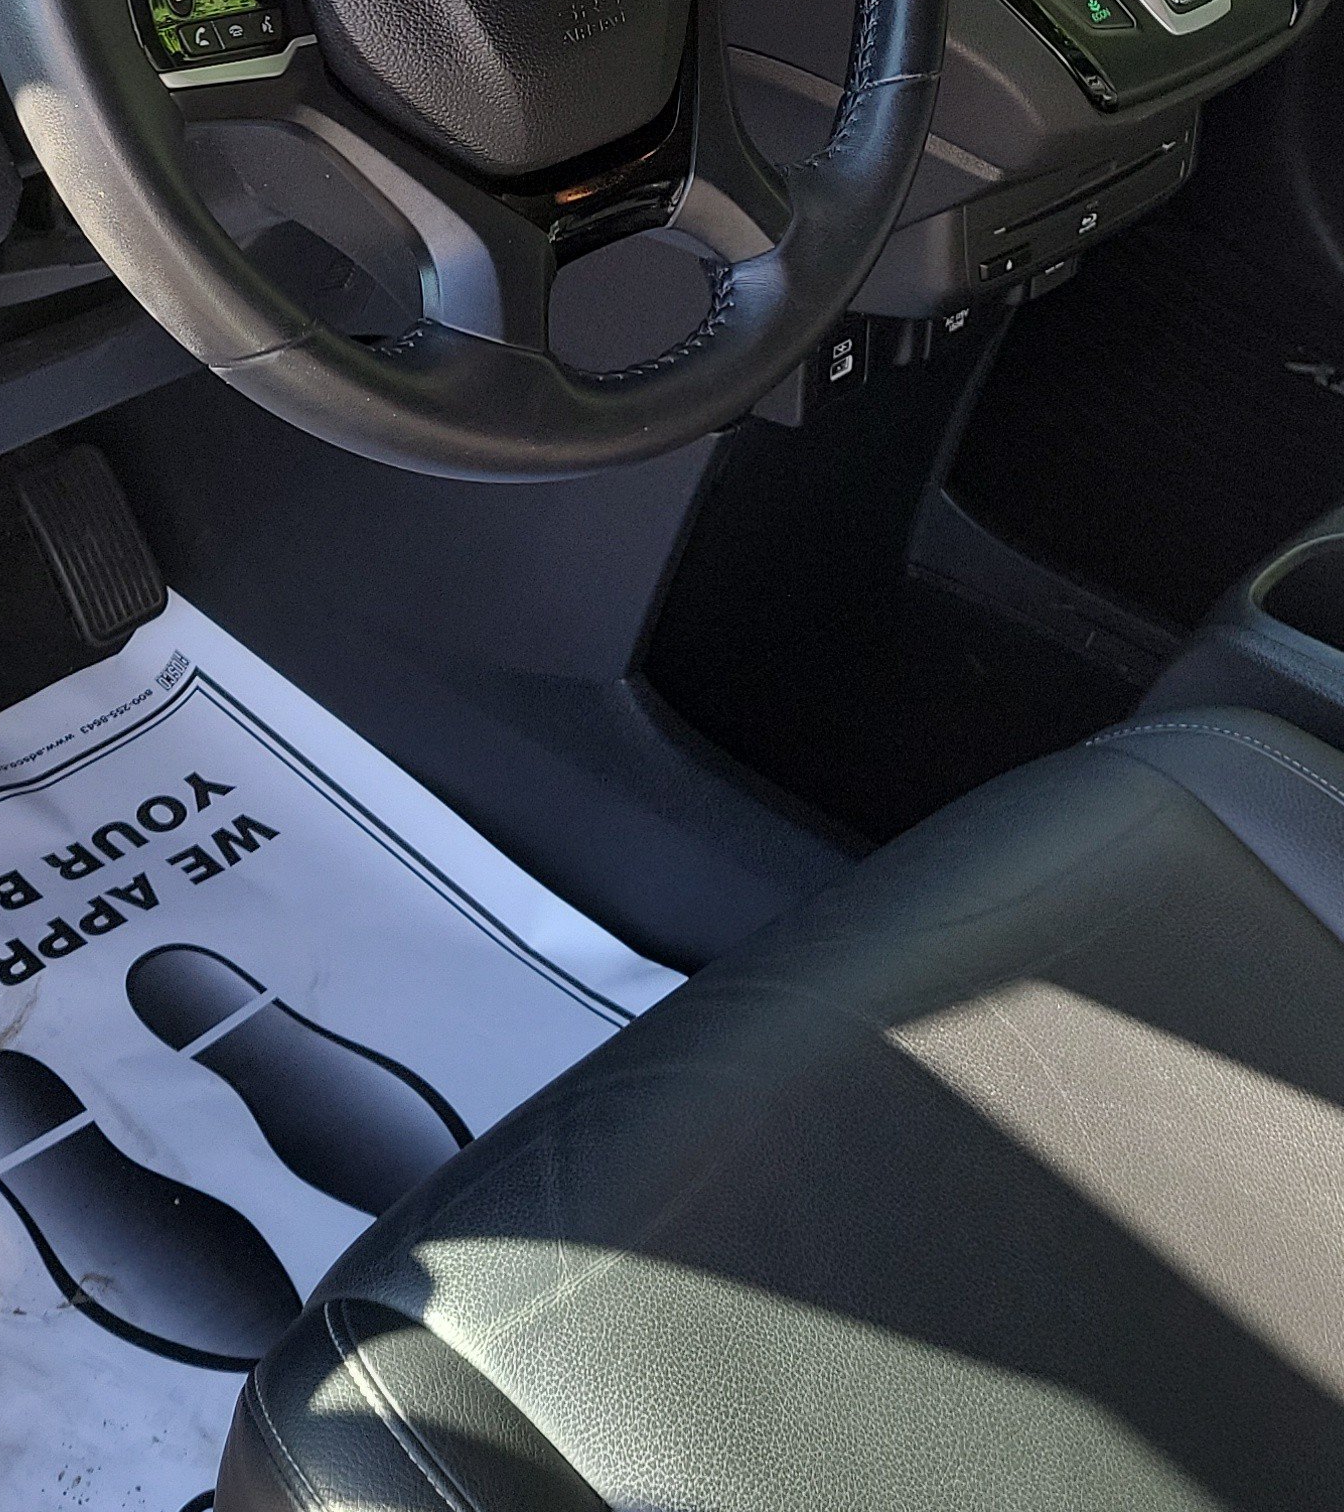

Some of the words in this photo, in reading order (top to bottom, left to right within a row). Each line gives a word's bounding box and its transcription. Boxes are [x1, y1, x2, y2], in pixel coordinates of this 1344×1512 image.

[1091, 7, 1111, 23] ECON
[42, 770, 237, 881] YOUR
[165, 813, 281, 887] WE
